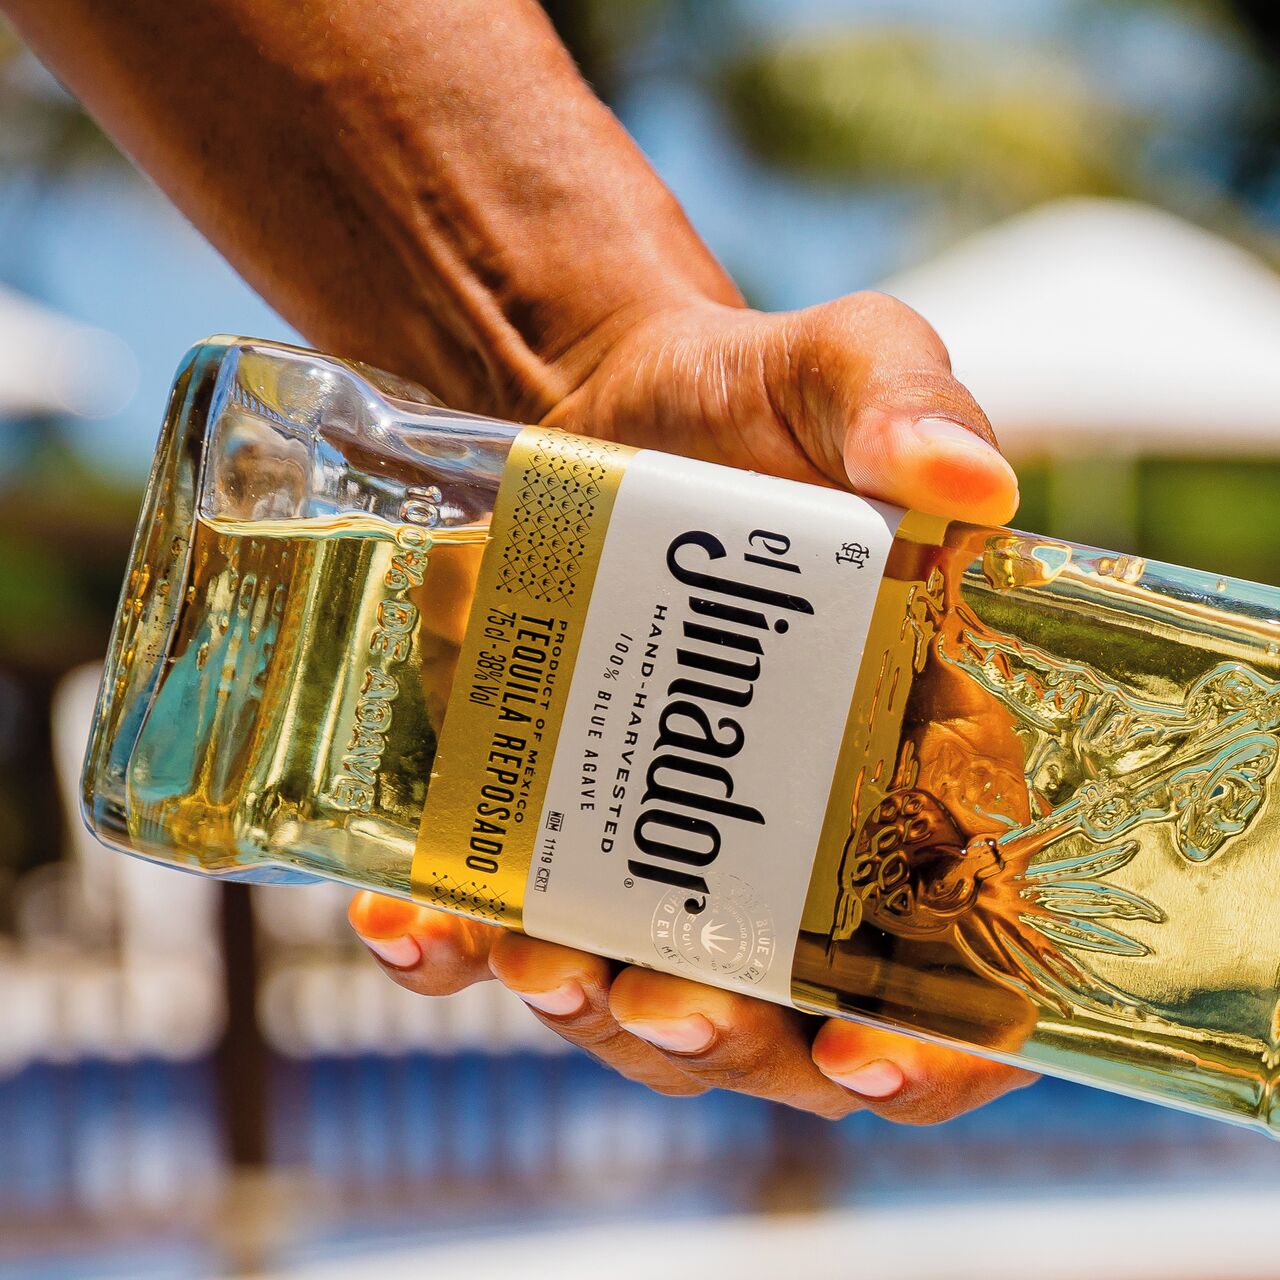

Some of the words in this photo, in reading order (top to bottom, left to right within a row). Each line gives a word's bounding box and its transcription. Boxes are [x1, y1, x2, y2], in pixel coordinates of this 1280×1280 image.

[744, 529, 802, 574] el
[370, 600, 418, 663] DE
[474, 651, 507, 684] 38%
[498, 615, 555, 723] TEQUILA
[539, 620, 568, 710] PRODUCT
[603, 633, 633, 681] 100%
[469, 684, 499, 708] Vol
[588, 690, 612, 739] BLUE
[534, 718, 546, 742] OF
[601, 604, 667, 853] HAND-HARVESTED
[628, 530, 815, 915] Jimador
[465, 732, 526, 874] REPOSADO
[514, 750, 538, 823] MÉXICO
[580, 749, 599, 811] AGAVE
[547, 810, 563, 832] NOM
[541, 837, 557, 864] 1119
[535, 867, 549, 892] CRT
